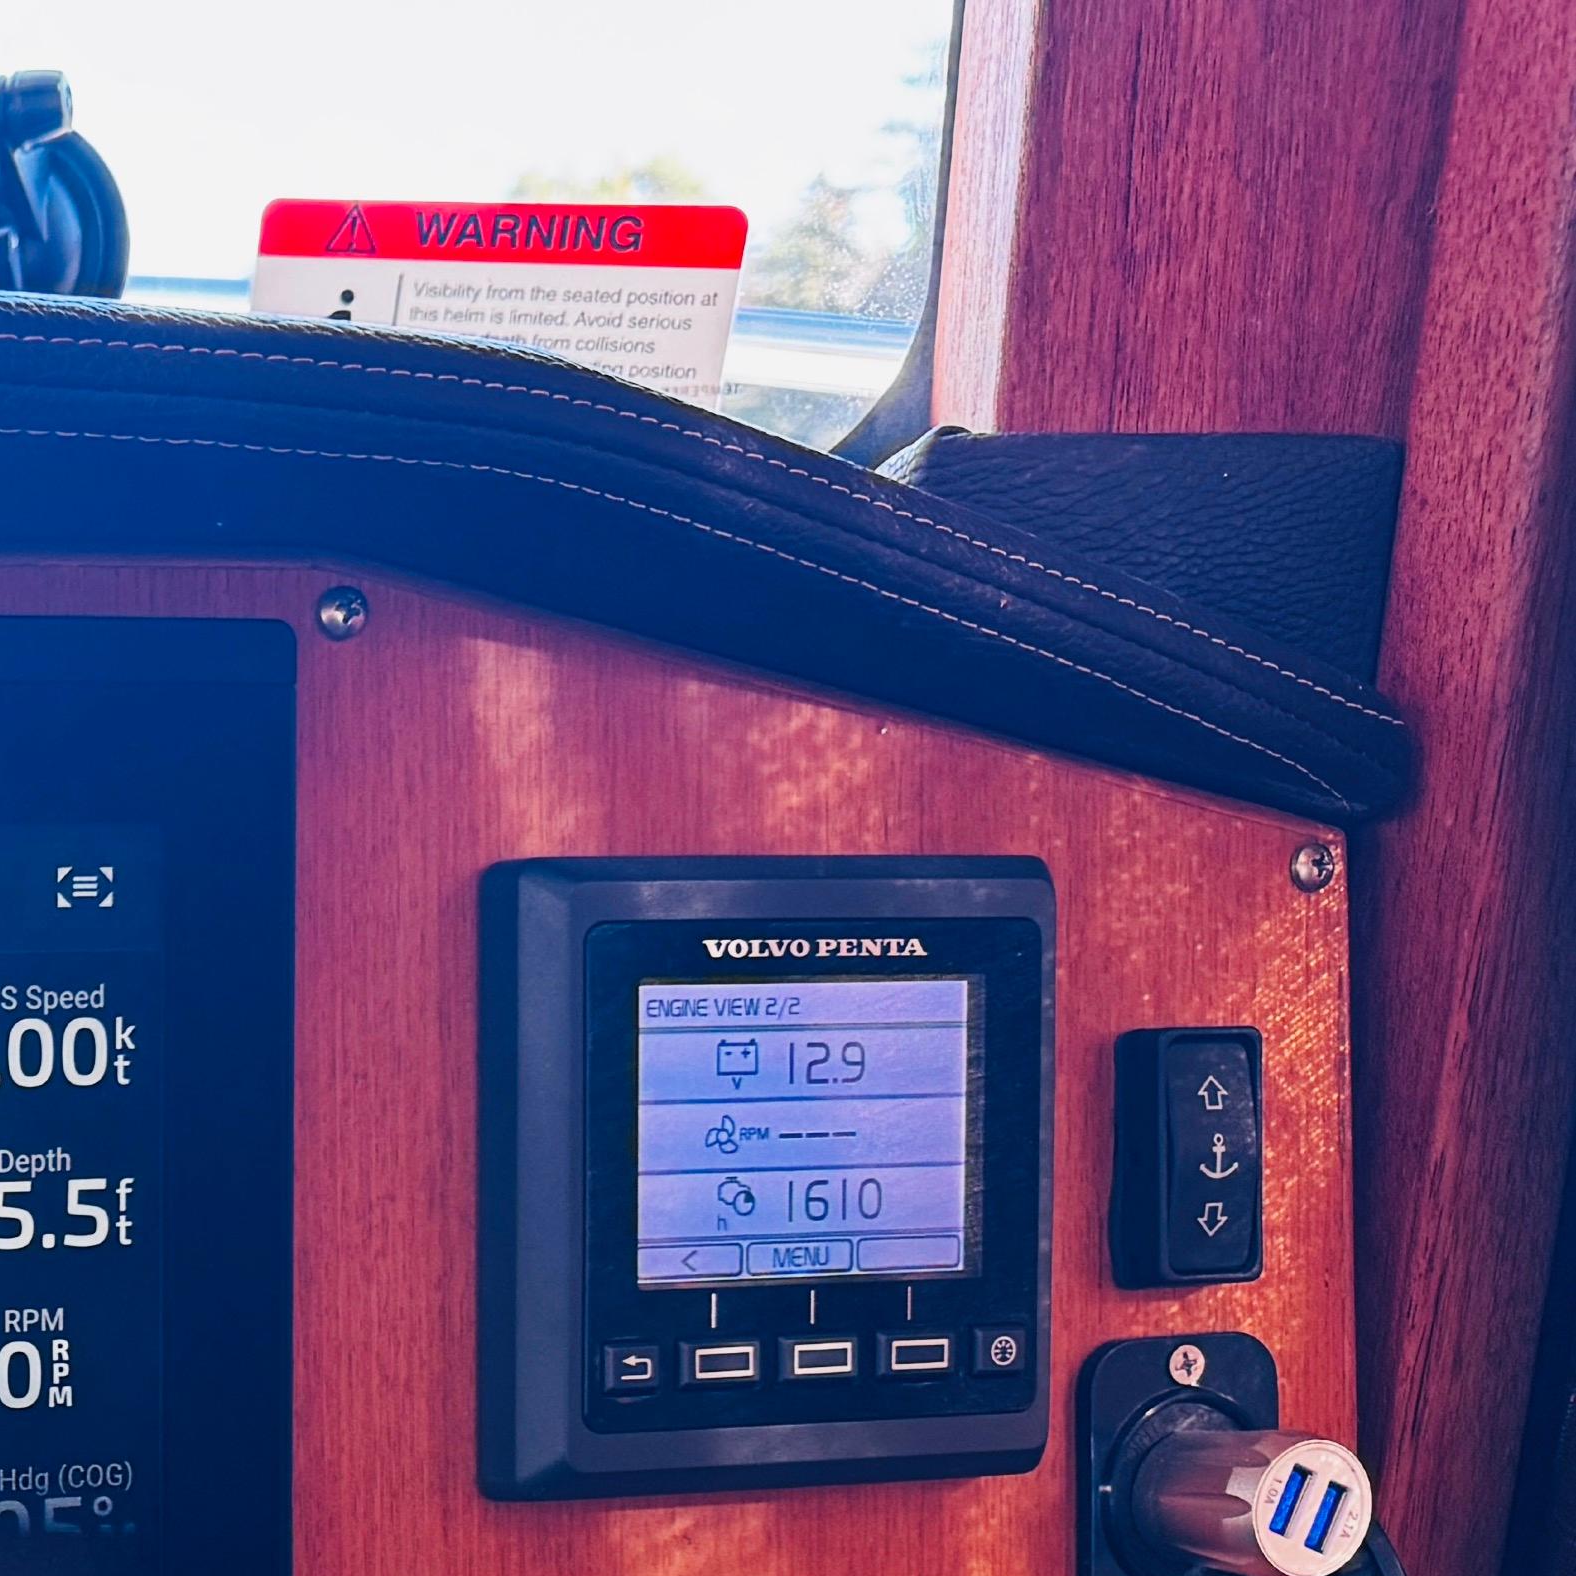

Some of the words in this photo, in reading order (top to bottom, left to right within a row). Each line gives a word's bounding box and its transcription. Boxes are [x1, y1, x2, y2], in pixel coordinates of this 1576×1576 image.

[416, 211, 645, 252] WARNING
[413, 282, 482, 303] Visibility
[486, 284, 525, 301] from
[530, 285, 557, 301] the
[562, 288, 623, 304] seated
[626, 290, 695, 307] position
[701, 292, 718, 307] at
[409, 306, 439, 322] this
[443, 308, 485, 323] helm
[490, 309, 504, 325] is
[573, 311, 624, 328] Avoid
[627, 313, 693, 331] serious
[532, 333, 571, 350] from
[575, 336, 656, 354] collisions
[628, 362, 697, 379] position
[702, 939, 810, 959] VOLVO
[815, 937, 928, 957] PENTA
[25, 983, 105, 1015] Speed
[646, 999, 709, 1018] ENGINE
[713, 998, 760, 1017] VIEW
[765, 997, 801, 1017] 2/2
[788, 1041, 866, 1085] 12.9
[739, 1127, 770, 1142] RPM
[788, 1177, 883, 1222] 1610
[772, 1246, 830, 1268] MENU
[4, 1307, 65, 1333] RPM
[0, 1466, 49, 1496] Hdg
[58, 1461, 133, 1494] (COG)
[1264, 1477, 1283, 1505] 1.0A
[1339, 1509, 1359, 1539] 2.1A
